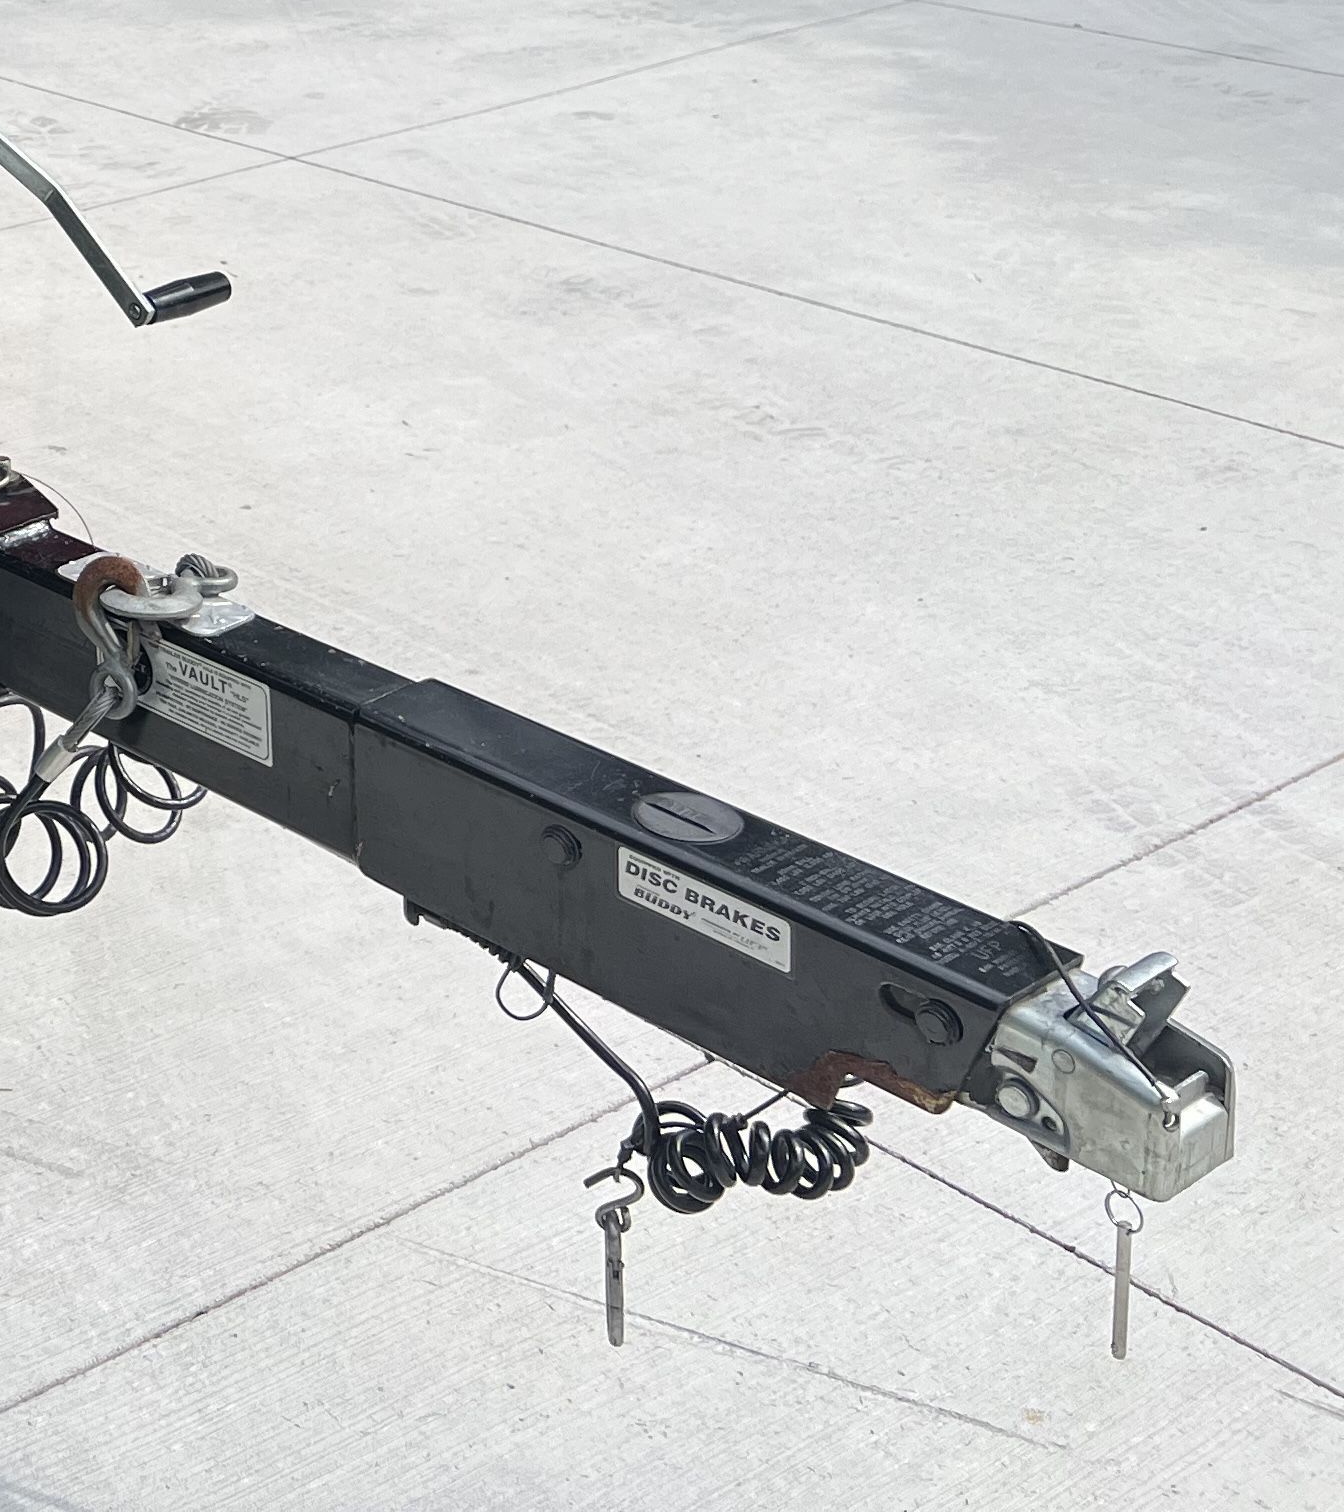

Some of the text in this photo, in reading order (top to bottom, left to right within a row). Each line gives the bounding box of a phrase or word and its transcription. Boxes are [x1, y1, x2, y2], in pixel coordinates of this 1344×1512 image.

[179, 660, 228, 694] VAULT
[625, 860, 678, 894] DISC
[684, 887, 781, 942] BRAKES
[633, 887, 693, 920] BUDDY
